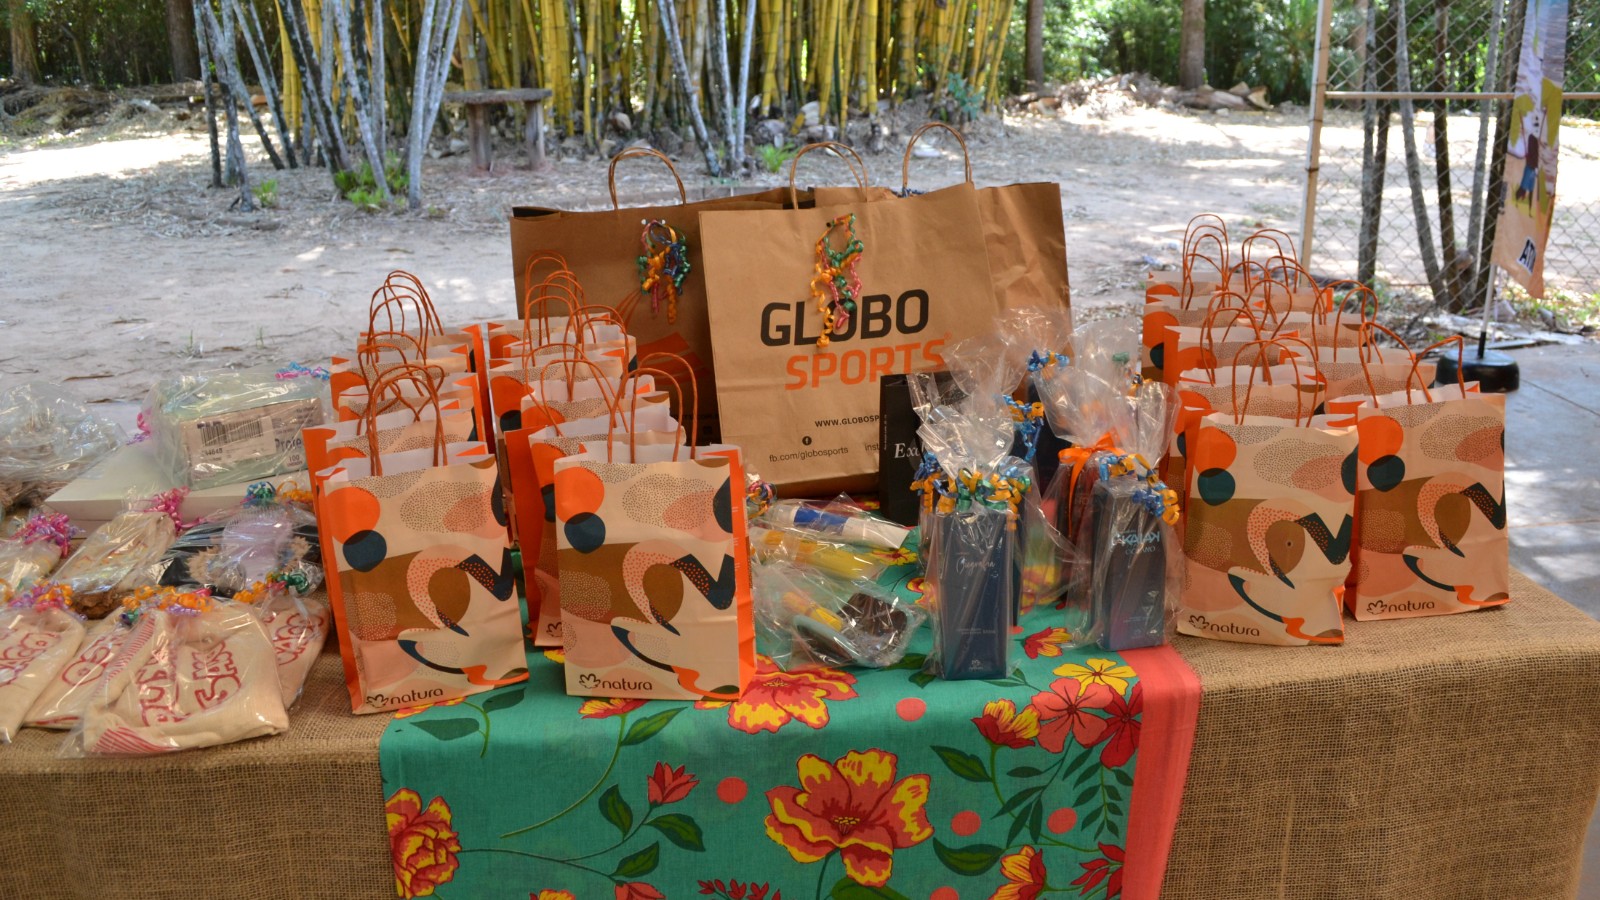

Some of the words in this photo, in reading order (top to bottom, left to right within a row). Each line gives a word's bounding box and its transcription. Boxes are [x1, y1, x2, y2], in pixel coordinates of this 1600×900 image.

[760, 289, 929, 346] GLOBO
[784, 340, 945, 391] SPORTS
[769, 446, 849, 463] fb.com/globosports
[1388, 600, 1435, 613] natura
[1210, 622, 1260, 637] natura
[601, 677, 653, 691] natura
[388, 686, 444, 706] natura
